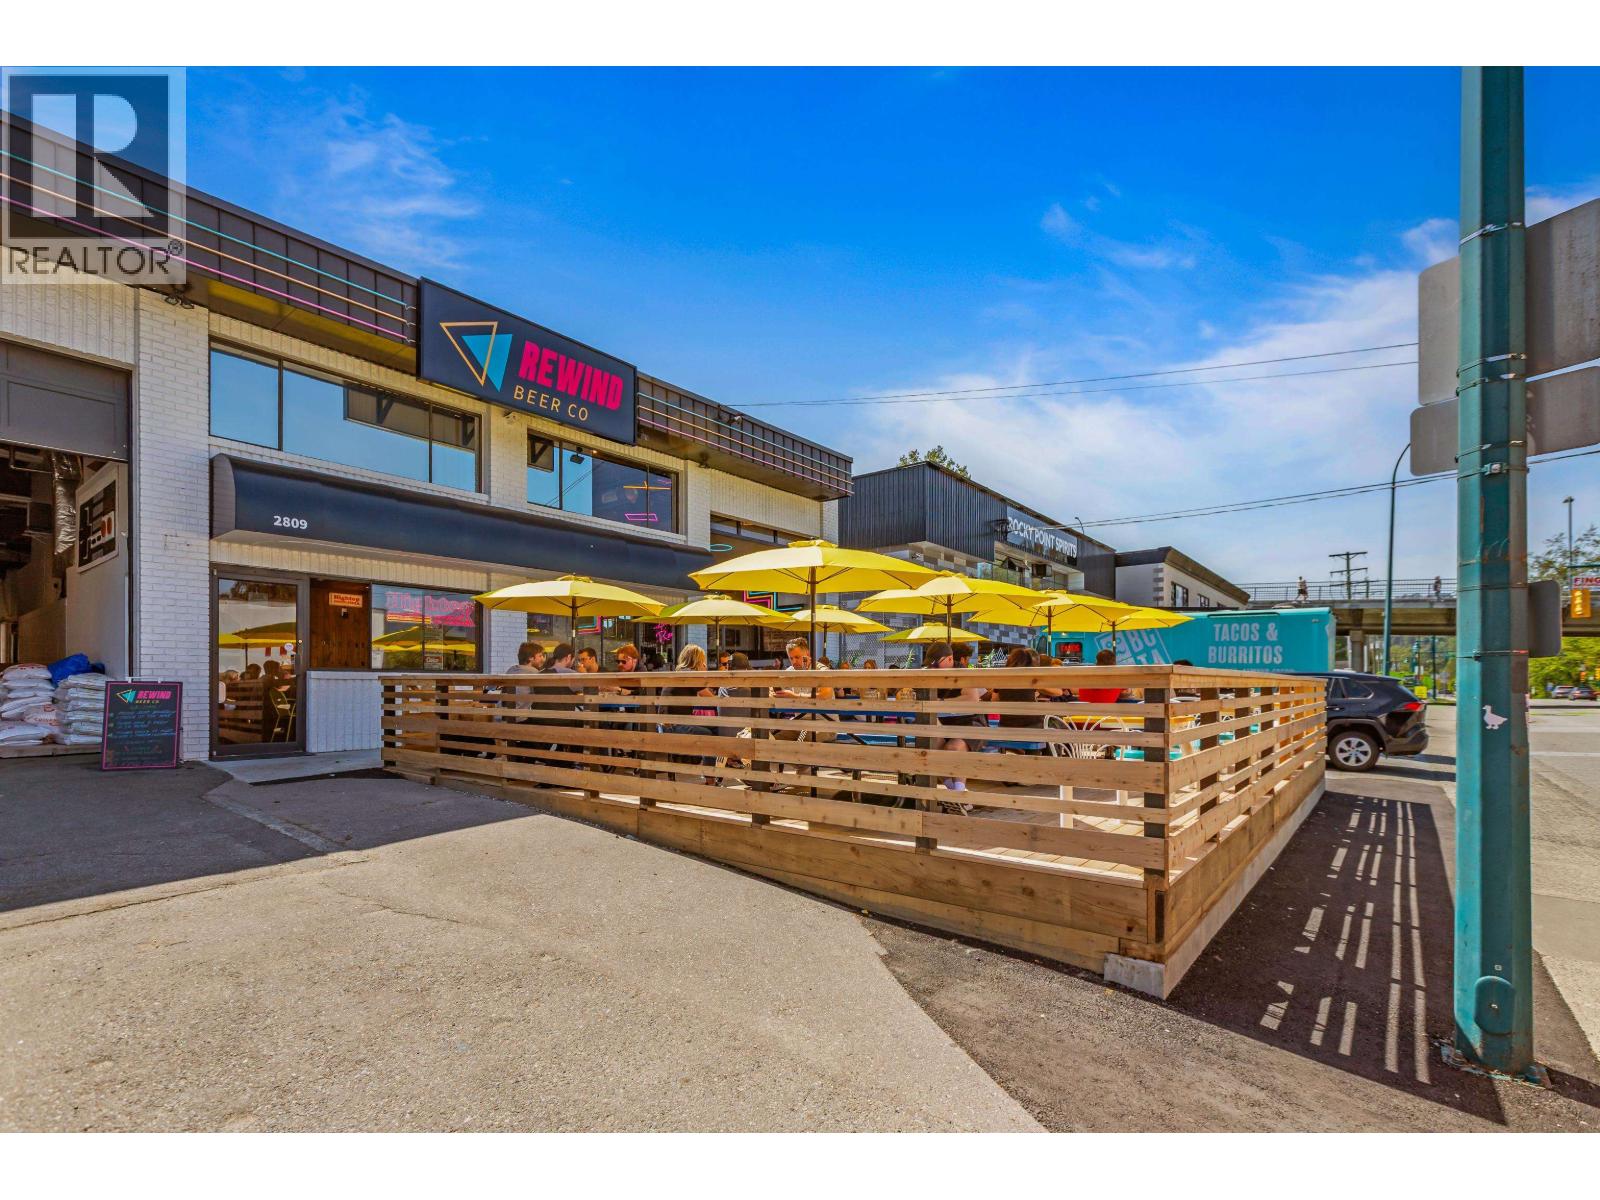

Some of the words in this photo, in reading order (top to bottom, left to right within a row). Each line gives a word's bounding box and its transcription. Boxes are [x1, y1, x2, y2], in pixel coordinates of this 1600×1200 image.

[518, 340, 624, 411] REWIND
[513, 384, 561, 413] BEER
[567, 403, 589, 421] CO
[273, 515, 308, 530] 2809
[1007, 516, 1033, 540] ROCKY
[1034, 529, 1055, 550] POINT
[1055, 536, 1077, 559] SPIRITS
[1213, 623, 1260, 641] TACOS
[1266, 622, 1279, 641] &
[1207, 645, 1284, 665] BURRITOS
[137, 690, 172, 700] REWIND
